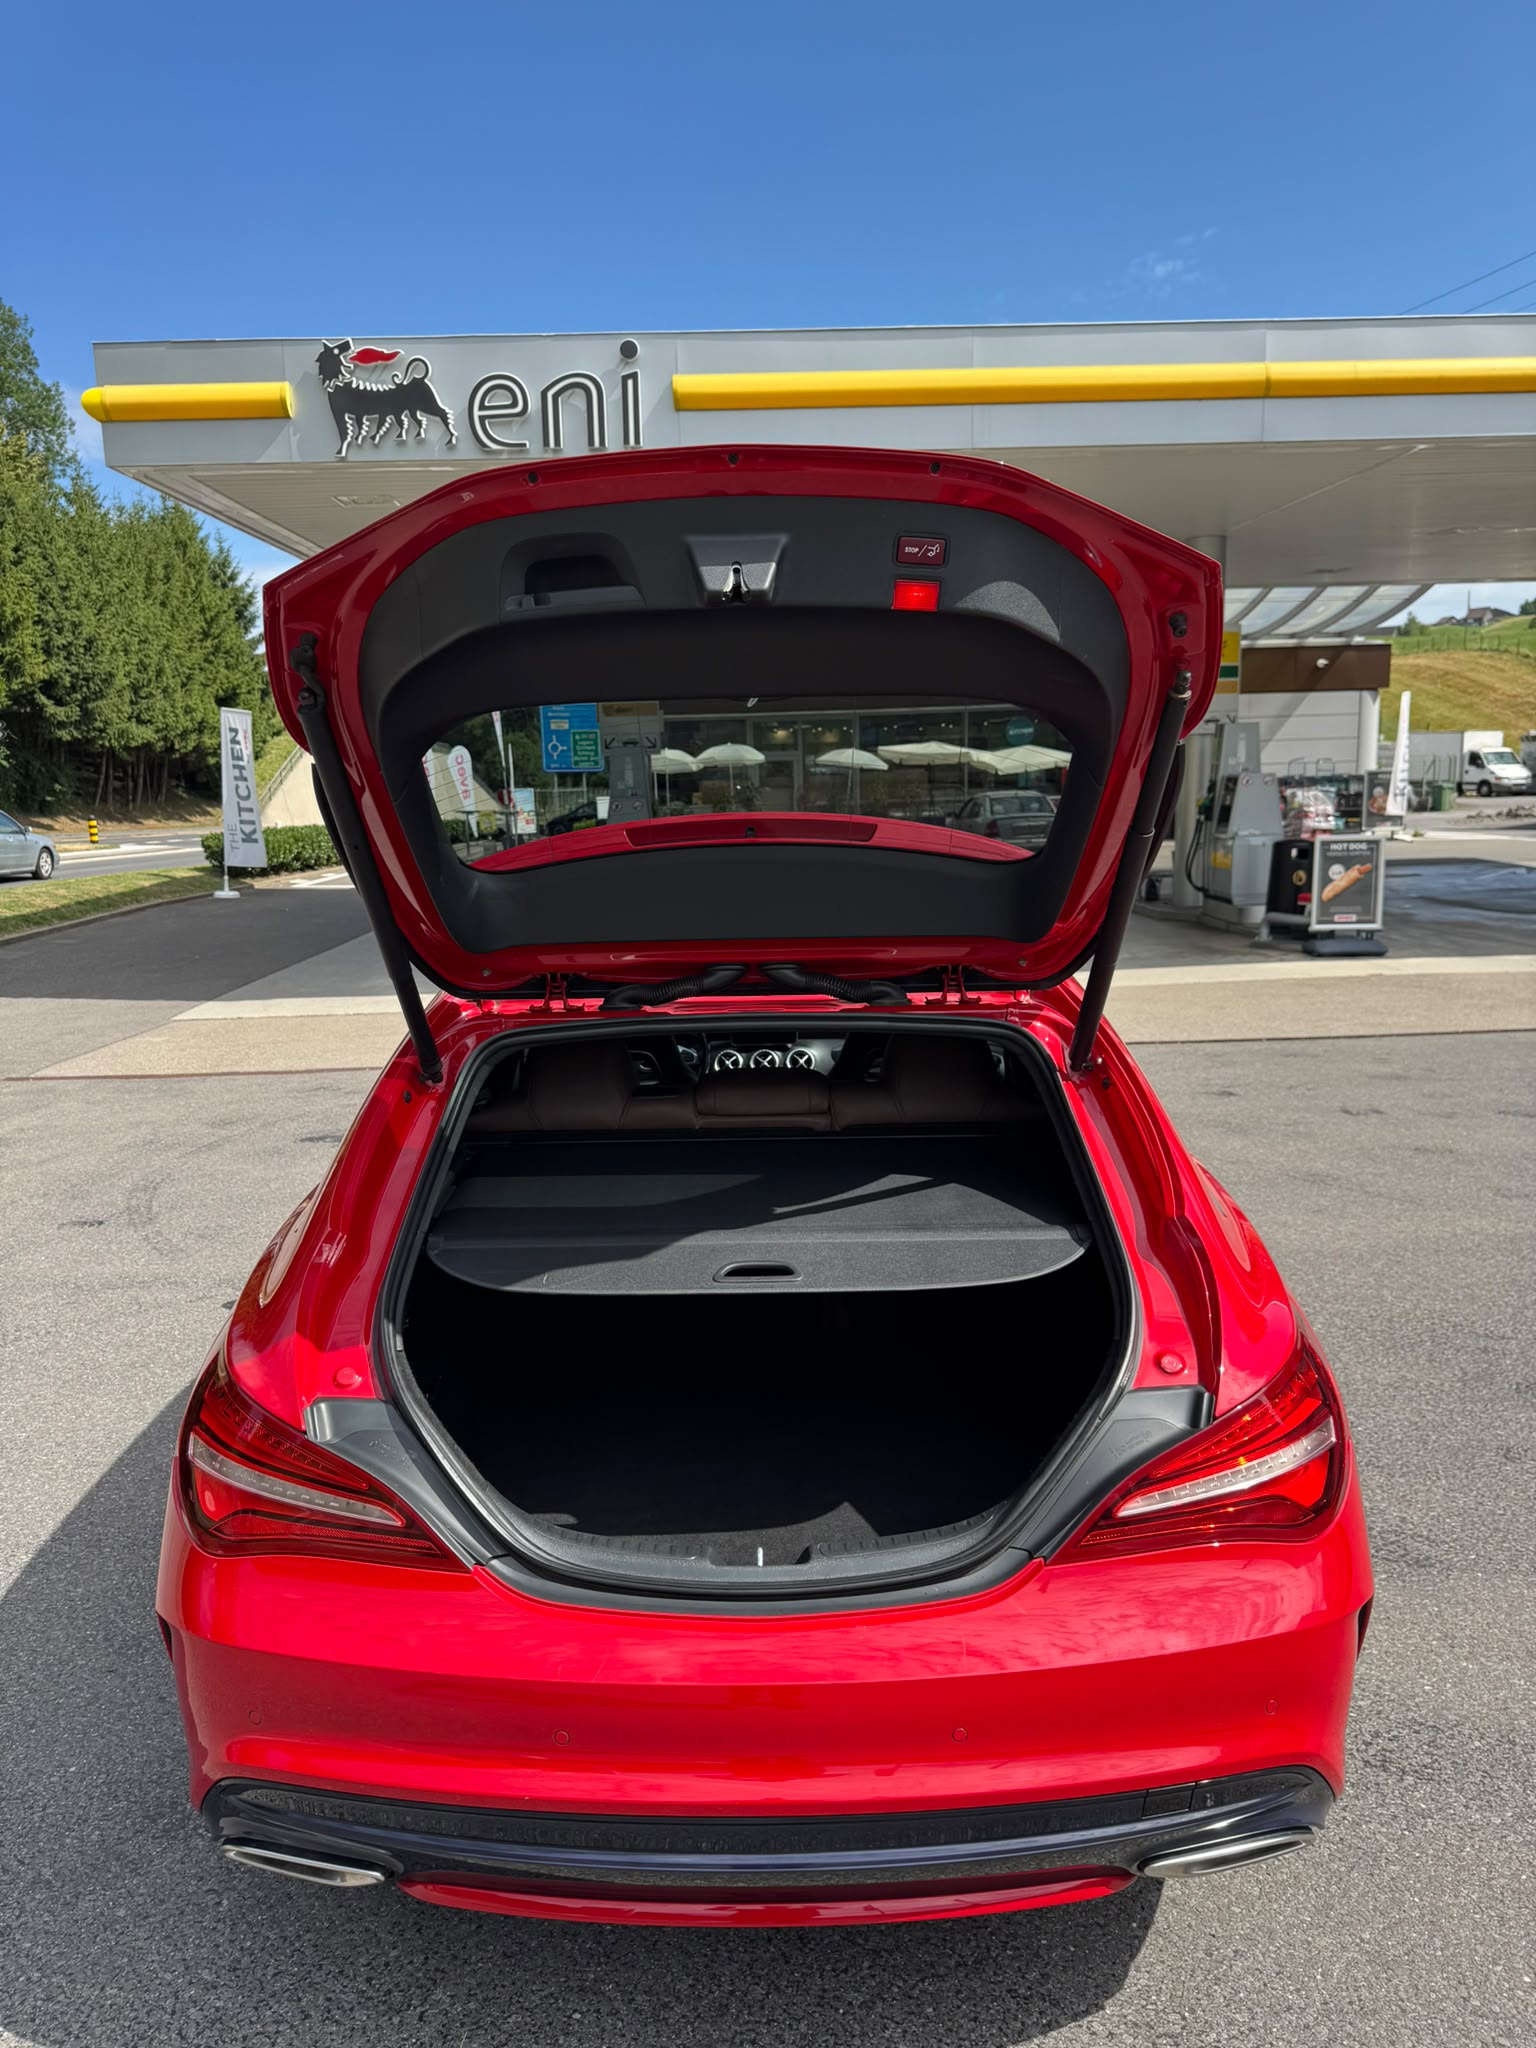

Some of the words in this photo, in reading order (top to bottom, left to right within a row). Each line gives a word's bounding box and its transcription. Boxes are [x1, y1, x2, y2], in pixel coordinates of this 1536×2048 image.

[468, 338, 643, 450] eni
[229, 727, 259, 844] KITCHEN
[228, 823, 240, 852] THE
[1330, 842, 1347, 850] HOT
[1349, 842, 1367, 850] DOG
